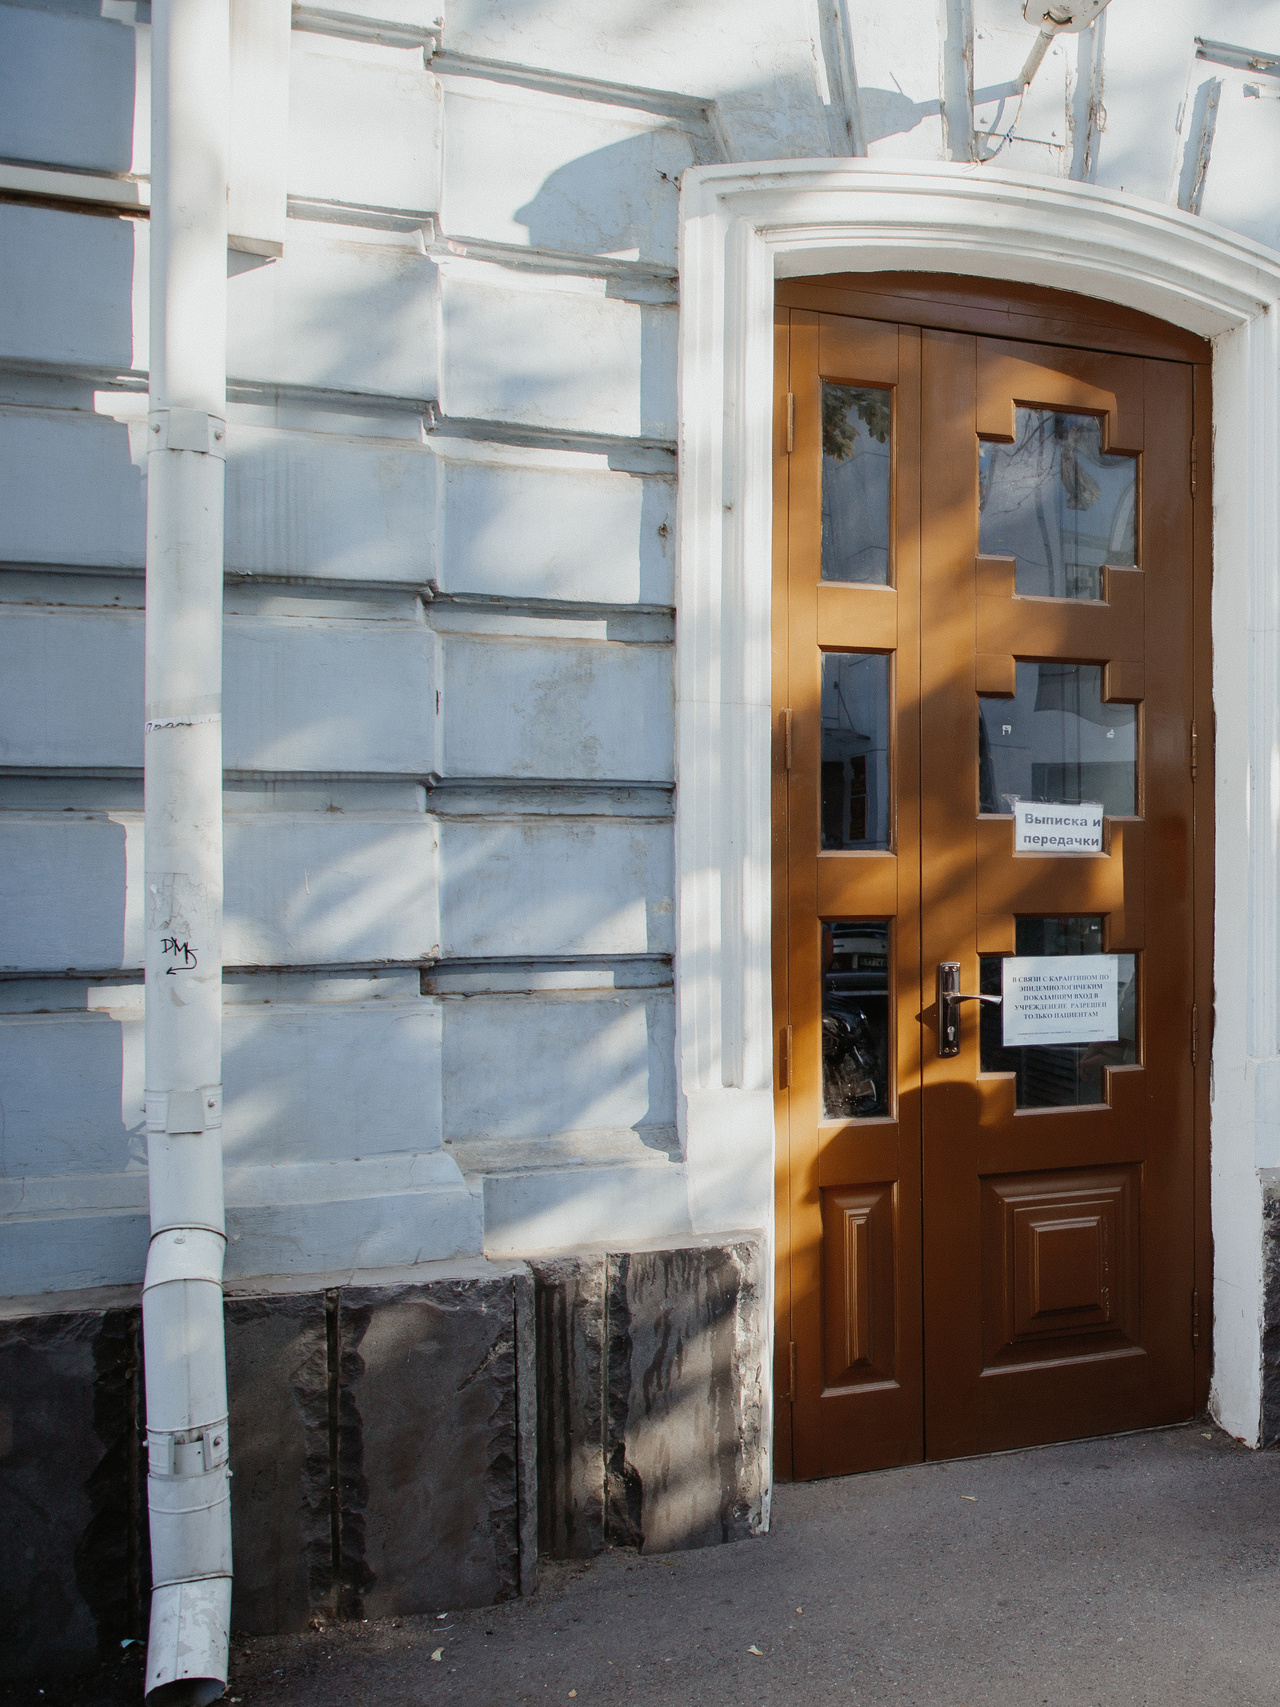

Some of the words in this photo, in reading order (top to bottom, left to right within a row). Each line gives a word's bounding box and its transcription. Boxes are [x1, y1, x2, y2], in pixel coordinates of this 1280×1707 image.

[1024, 813, 1088, 827] Выписка
[1024, 836, 1098, 846] передачки
[1054, 1011, 1099, 1019] ПАЦИЕНТАМ
